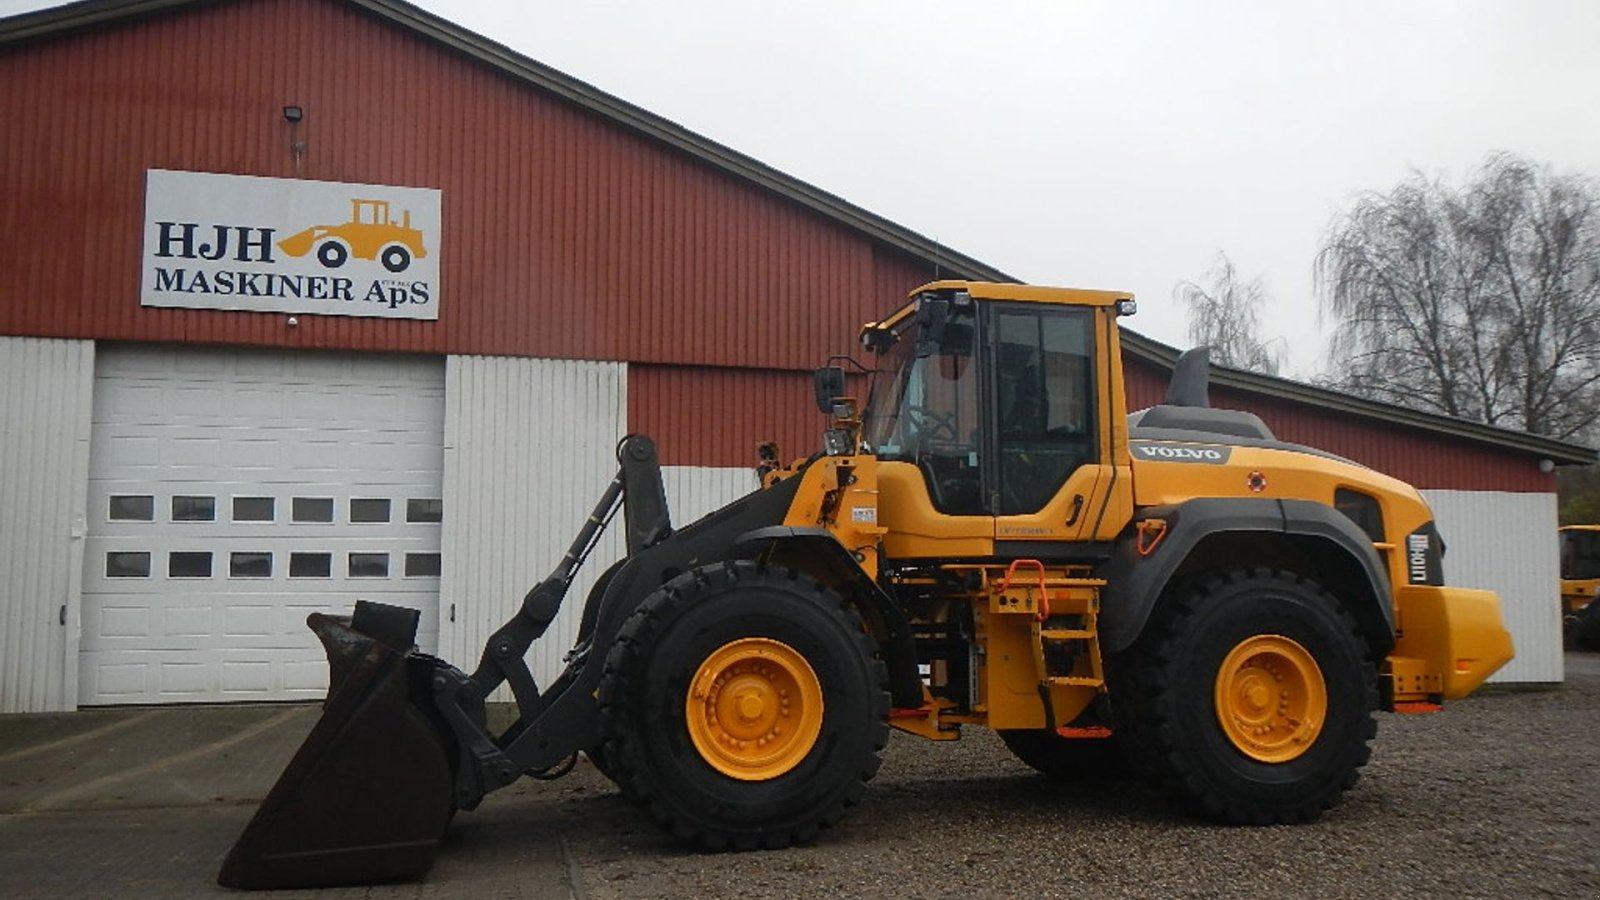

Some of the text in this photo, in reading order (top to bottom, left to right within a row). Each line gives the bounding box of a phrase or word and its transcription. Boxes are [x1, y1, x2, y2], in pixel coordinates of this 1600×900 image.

[154, 222, 276, 263] HJH
[153, 267, 429, 308] MASKINER ApS
[1139, 446, 1221, 459] VOLVO
